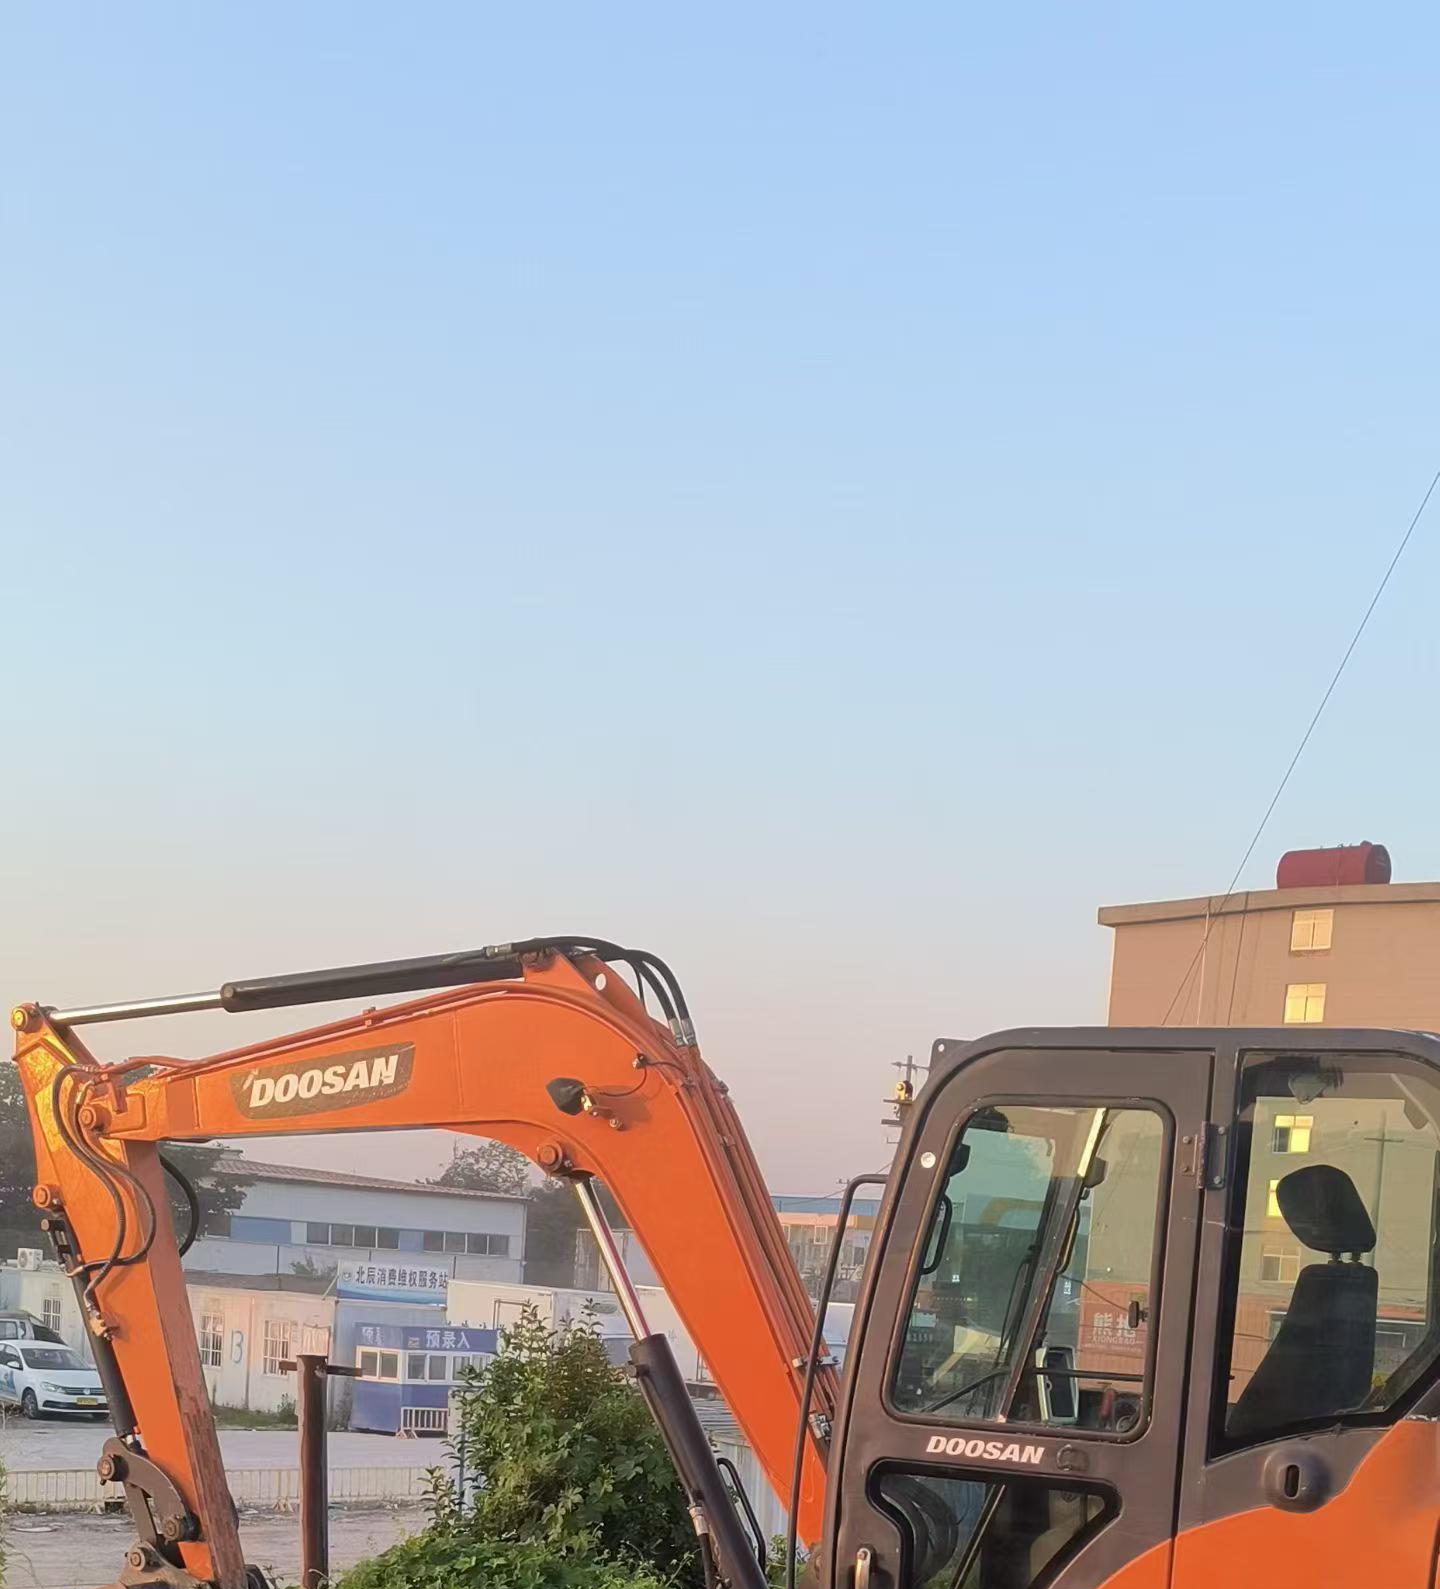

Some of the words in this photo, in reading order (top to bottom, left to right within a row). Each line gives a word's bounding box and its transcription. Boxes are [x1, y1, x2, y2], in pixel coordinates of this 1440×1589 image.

[249, 1054, 399, 1108] DOOSAN
[355, 1266, 449, 1290] 北辰消费维权服务站
[426, 1330, 471, 1349] 预录入
[925, 1435, 1046, 1465] DOOSAN
